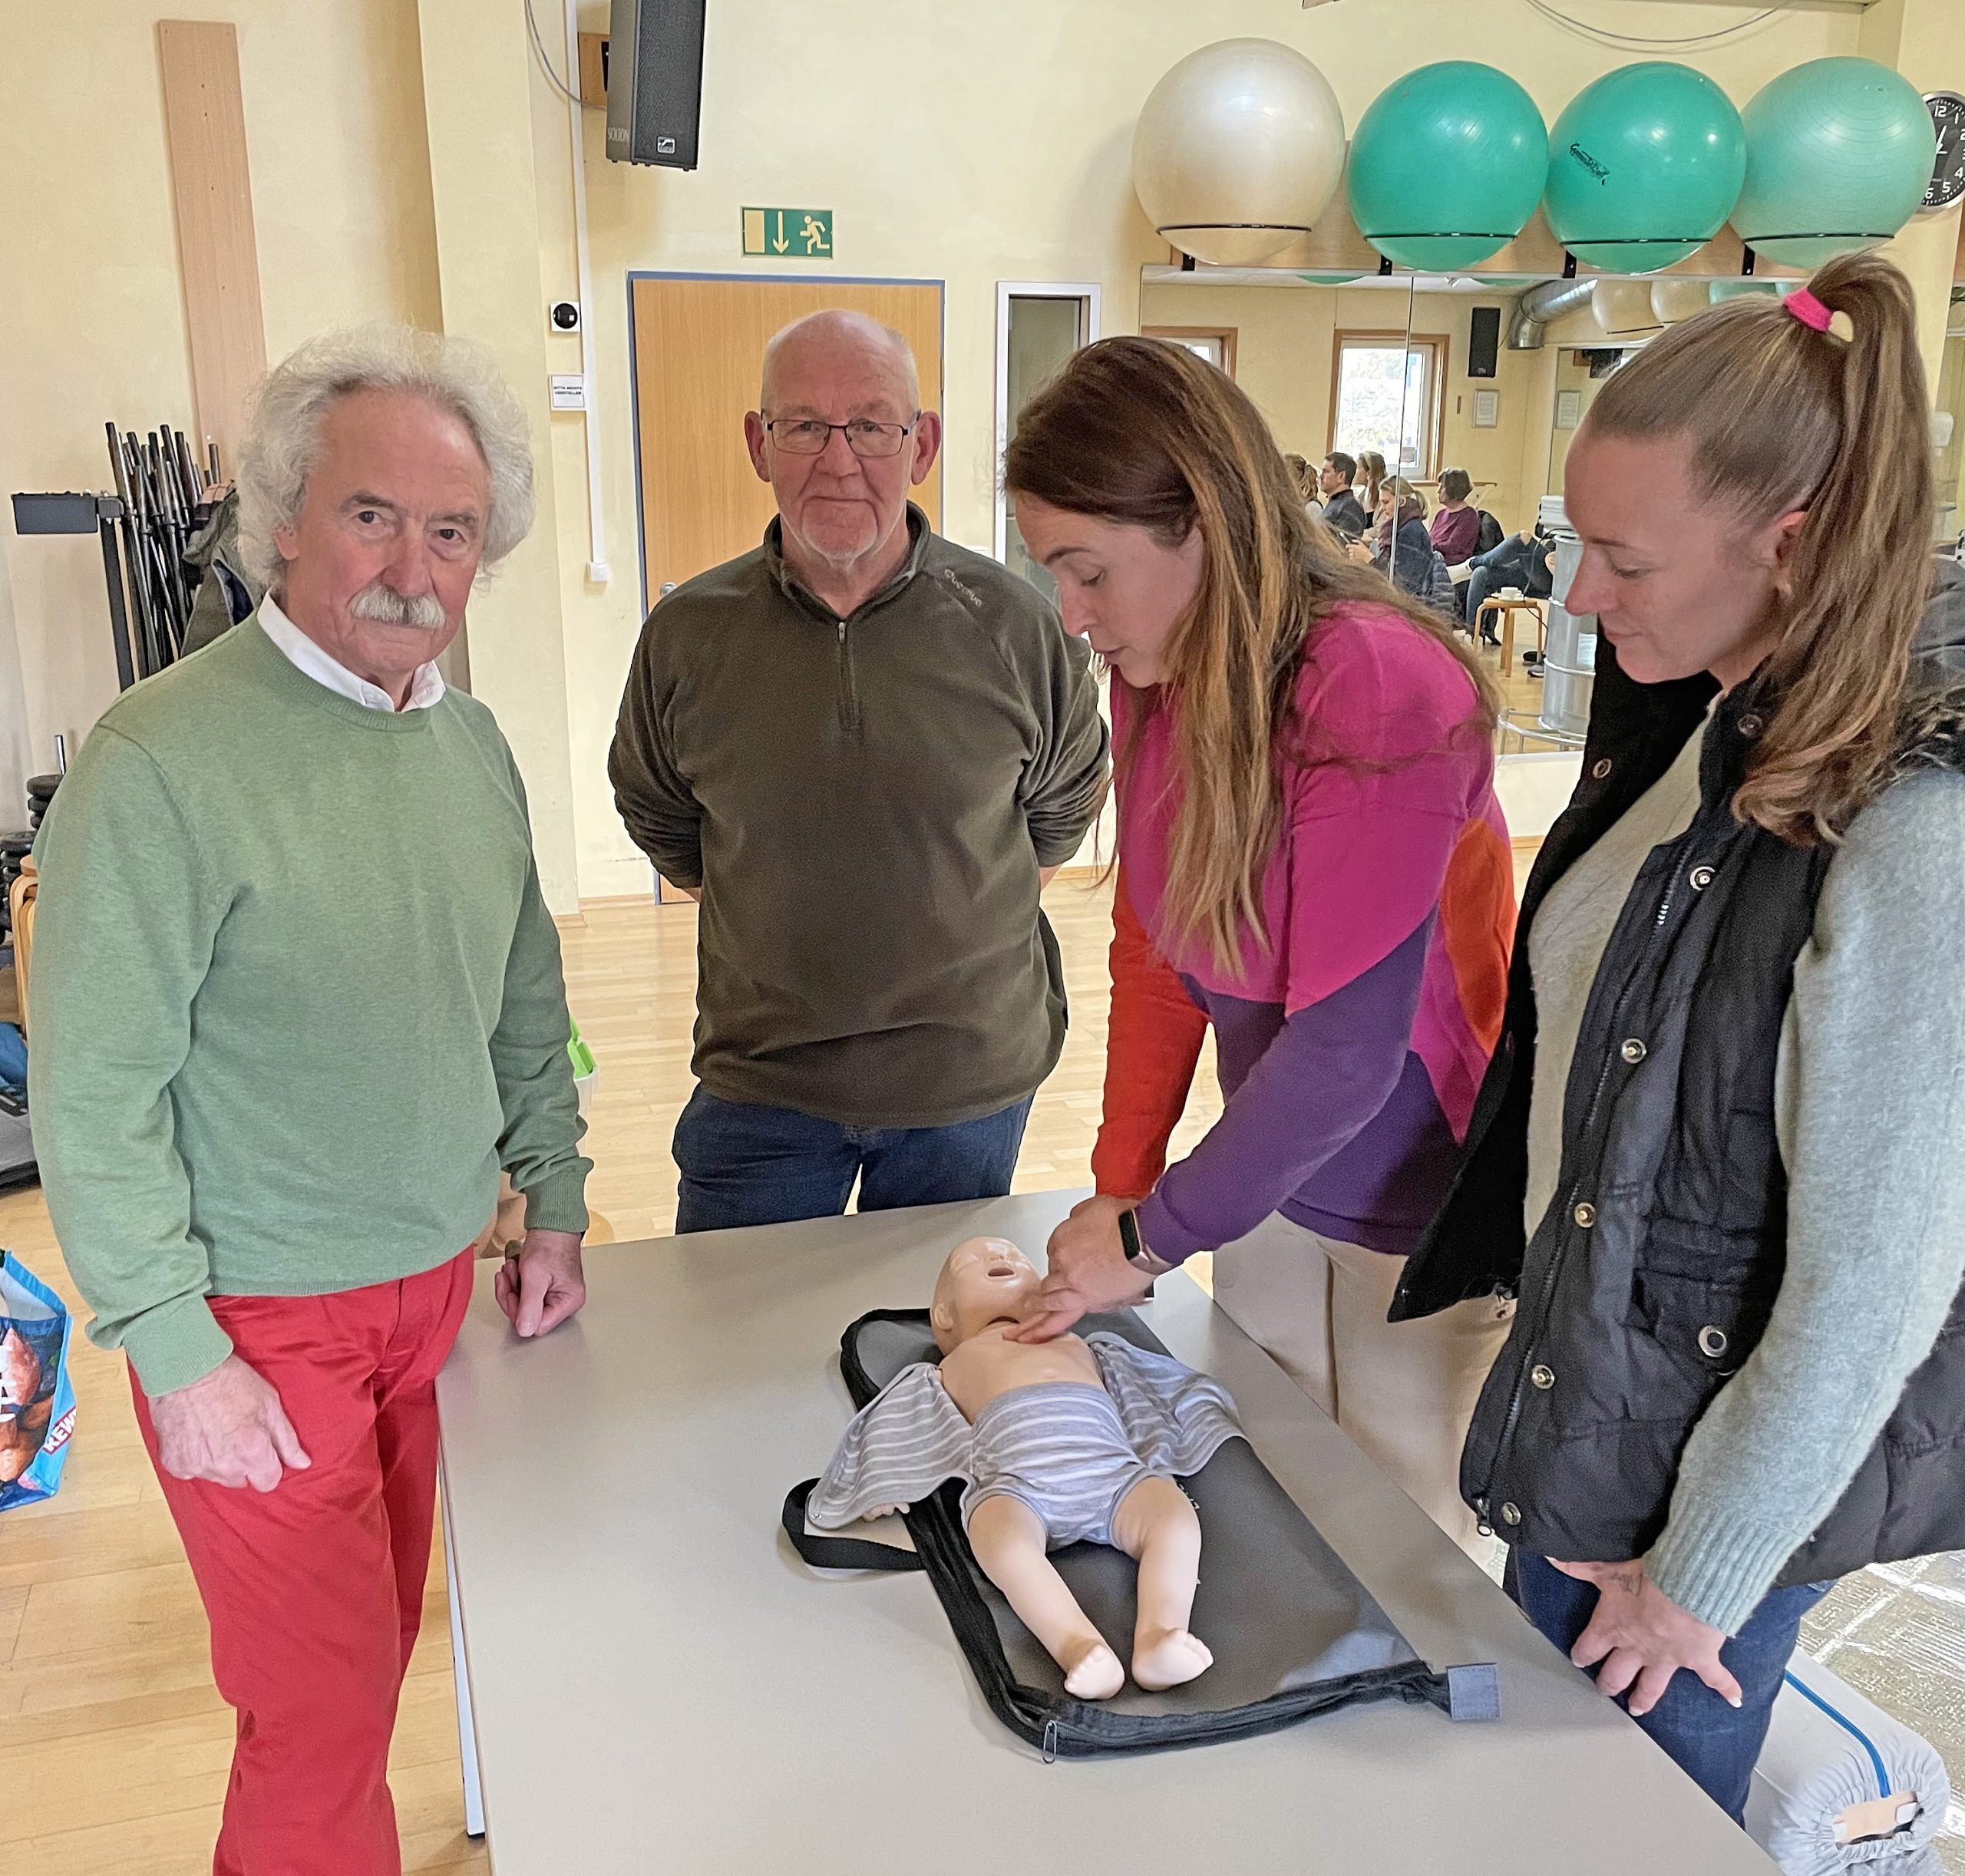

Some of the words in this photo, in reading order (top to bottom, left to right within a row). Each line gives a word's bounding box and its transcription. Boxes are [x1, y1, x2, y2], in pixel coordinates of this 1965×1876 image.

[1934, 105, 1947, 117] 12
[1954, 112, 1959, 124] 1
[1954, 167, 1963, 179] 4
[1925, 187, 1934, 199] 6
[1942, 181, 1951, 193] 5
